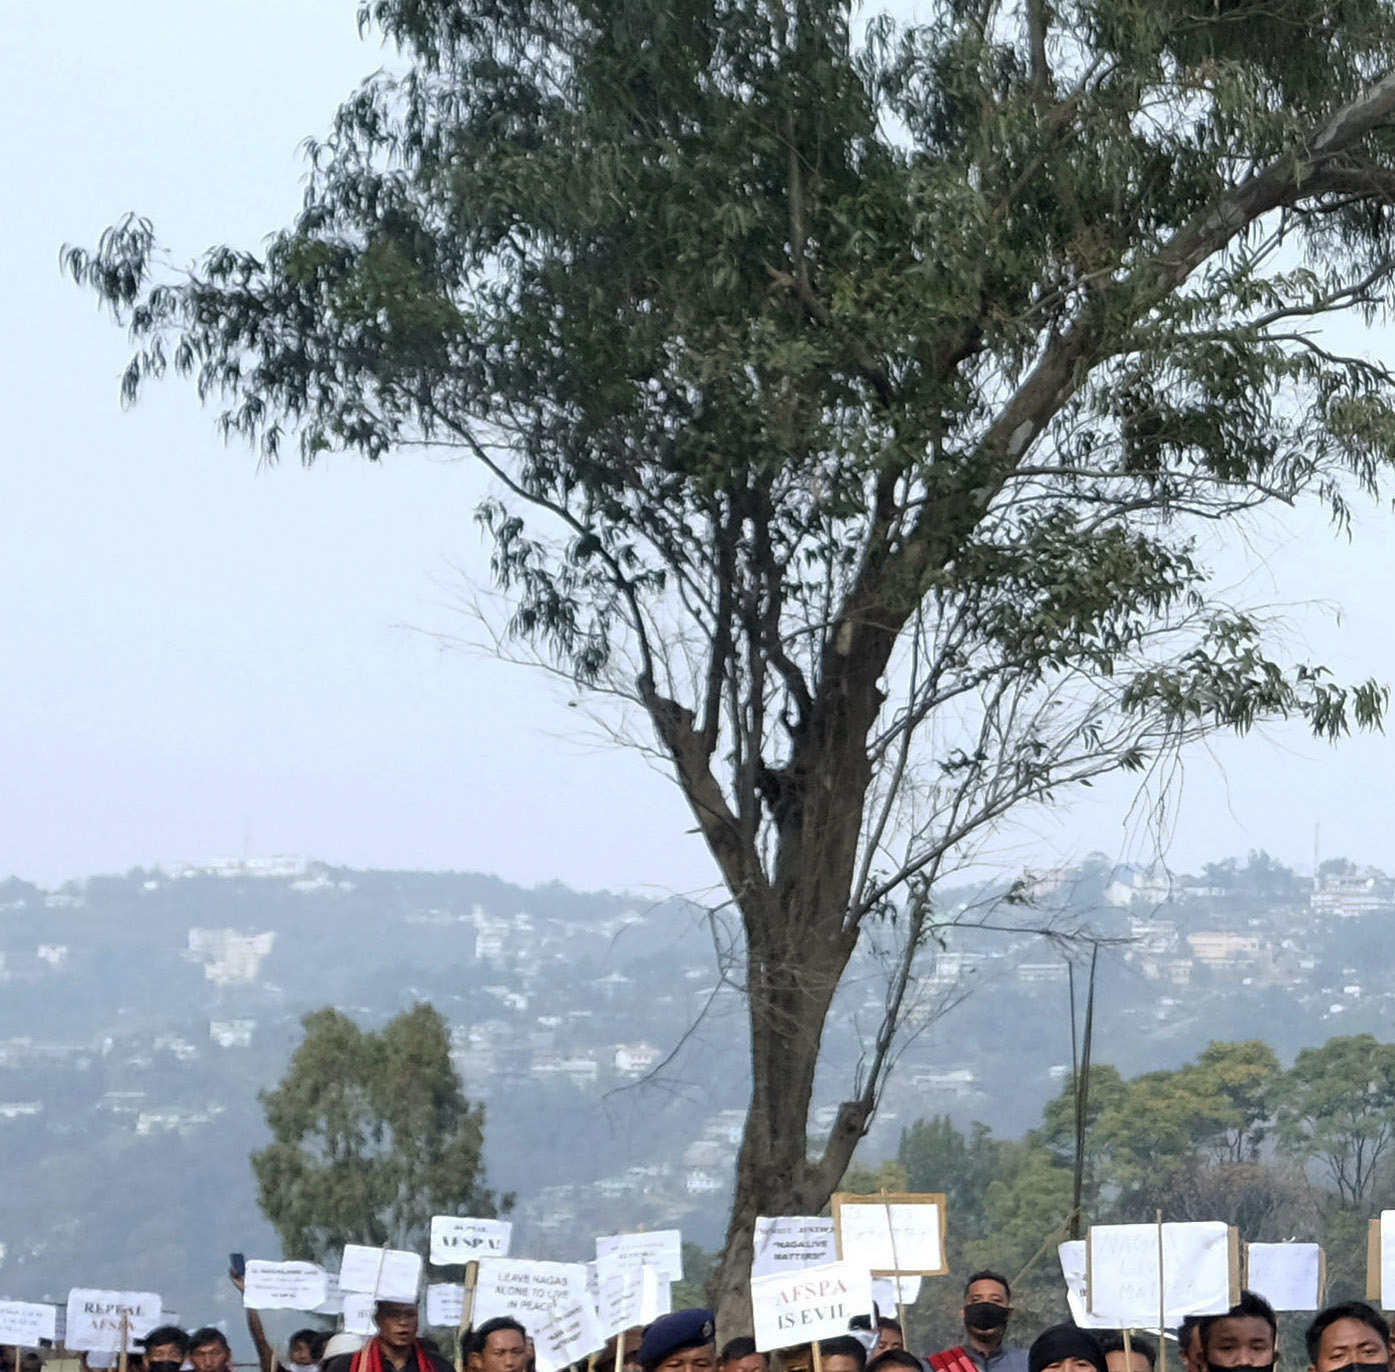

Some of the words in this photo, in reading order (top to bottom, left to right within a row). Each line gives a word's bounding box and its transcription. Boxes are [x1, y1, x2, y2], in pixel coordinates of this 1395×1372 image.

[775, 1279, 848, 1307] AFSPA
[84, 1302, 144, 1317] REPEAL
[778, 1312, 796, 1331] IS
[800, 1303, 850, 1325] EVIL
